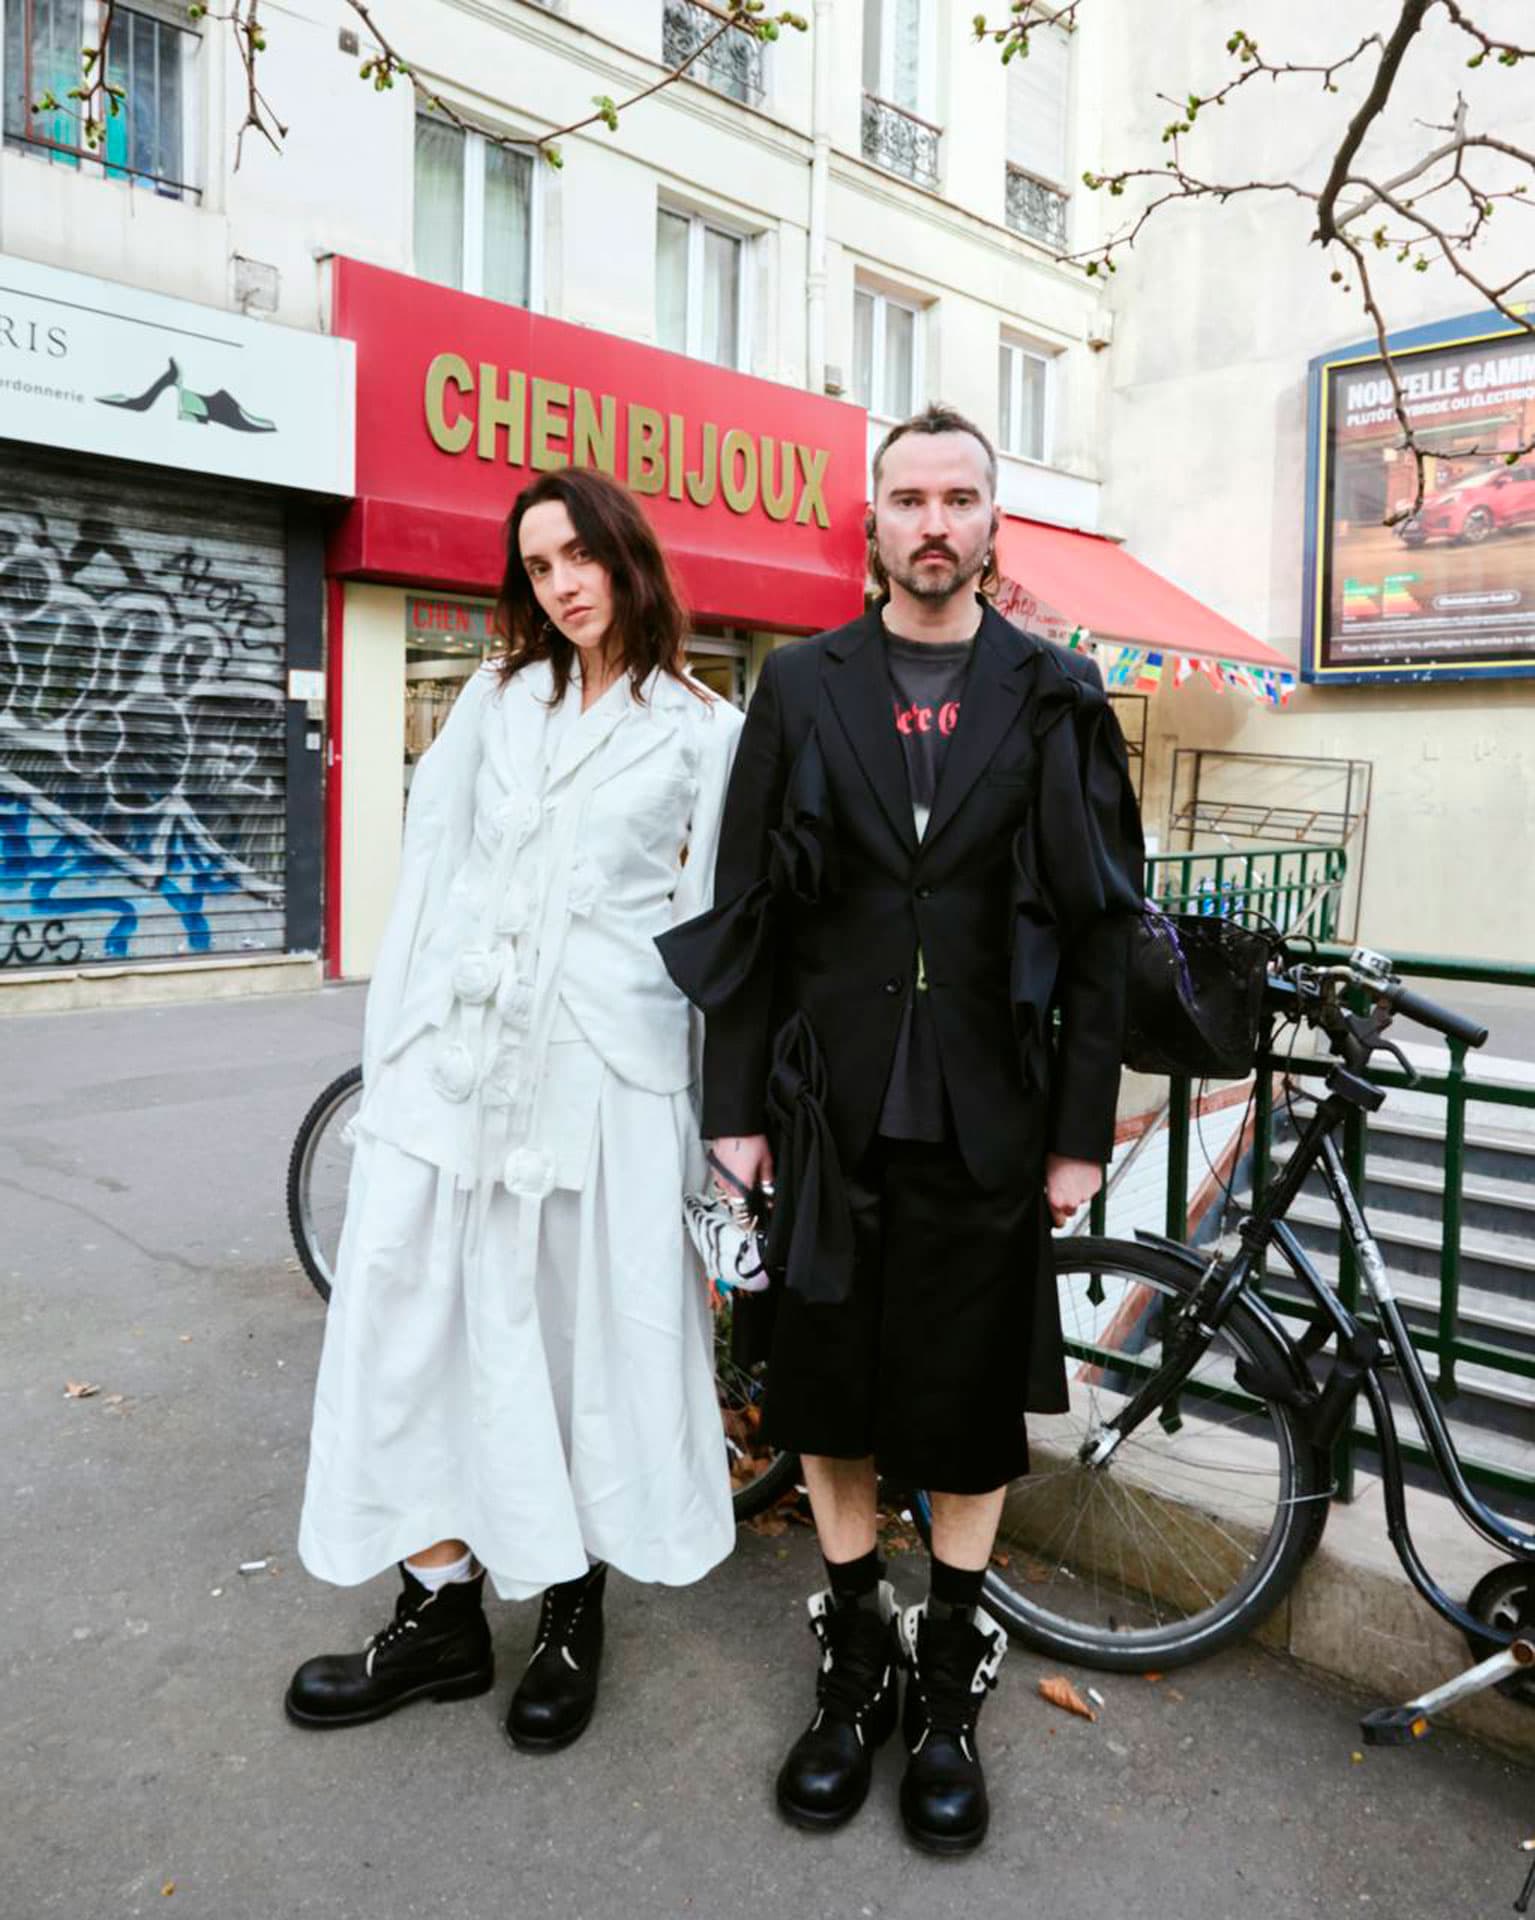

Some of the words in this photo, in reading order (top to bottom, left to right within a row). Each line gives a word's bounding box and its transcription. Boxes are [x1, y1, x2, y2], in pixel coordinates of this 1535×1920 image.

[424, 353, 617, 478] CHEN
[628, 403, 830, 528] BIJOUX
[1451, 396, 1469, 412] OU
